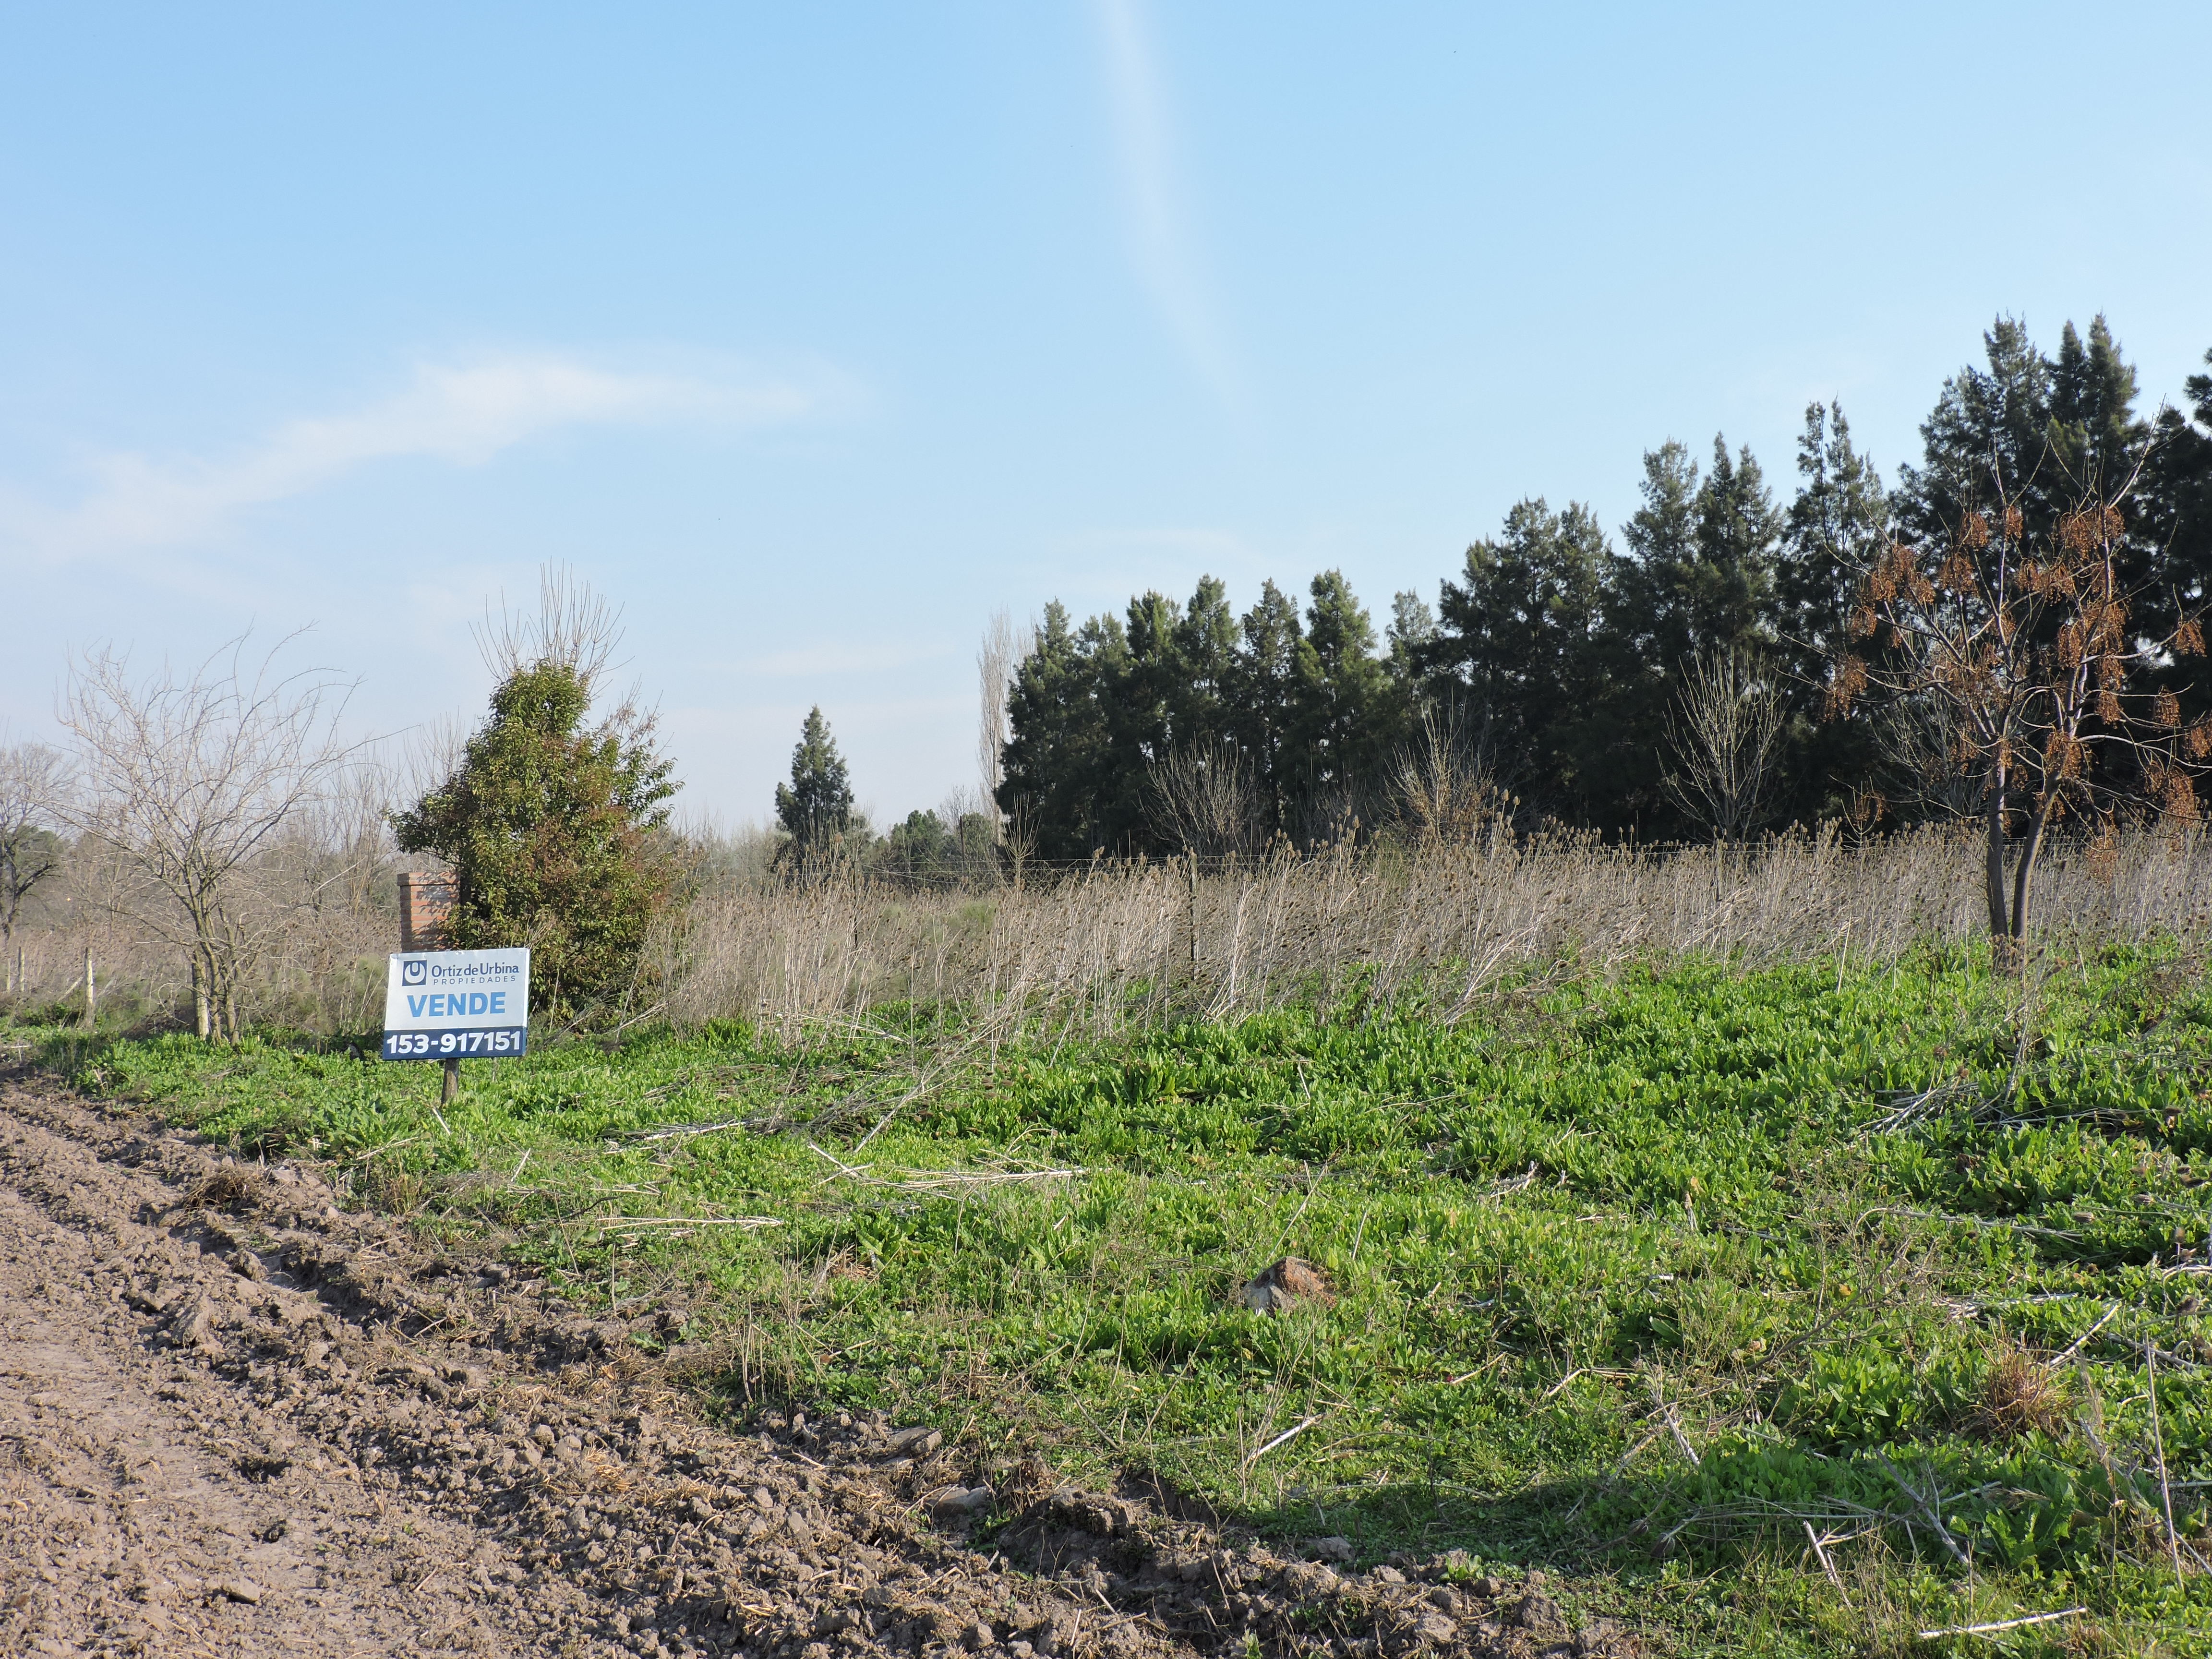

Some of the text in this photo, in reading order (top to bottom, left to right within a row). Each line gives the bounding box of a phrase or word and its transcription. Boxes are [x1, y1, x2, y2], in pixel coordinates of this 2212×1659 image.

[433, 976, 516, 985] PROPIEDADES
[407, 992, 506, 1017] VENDE
[387, 1031, 520, 1054] 153-917151
